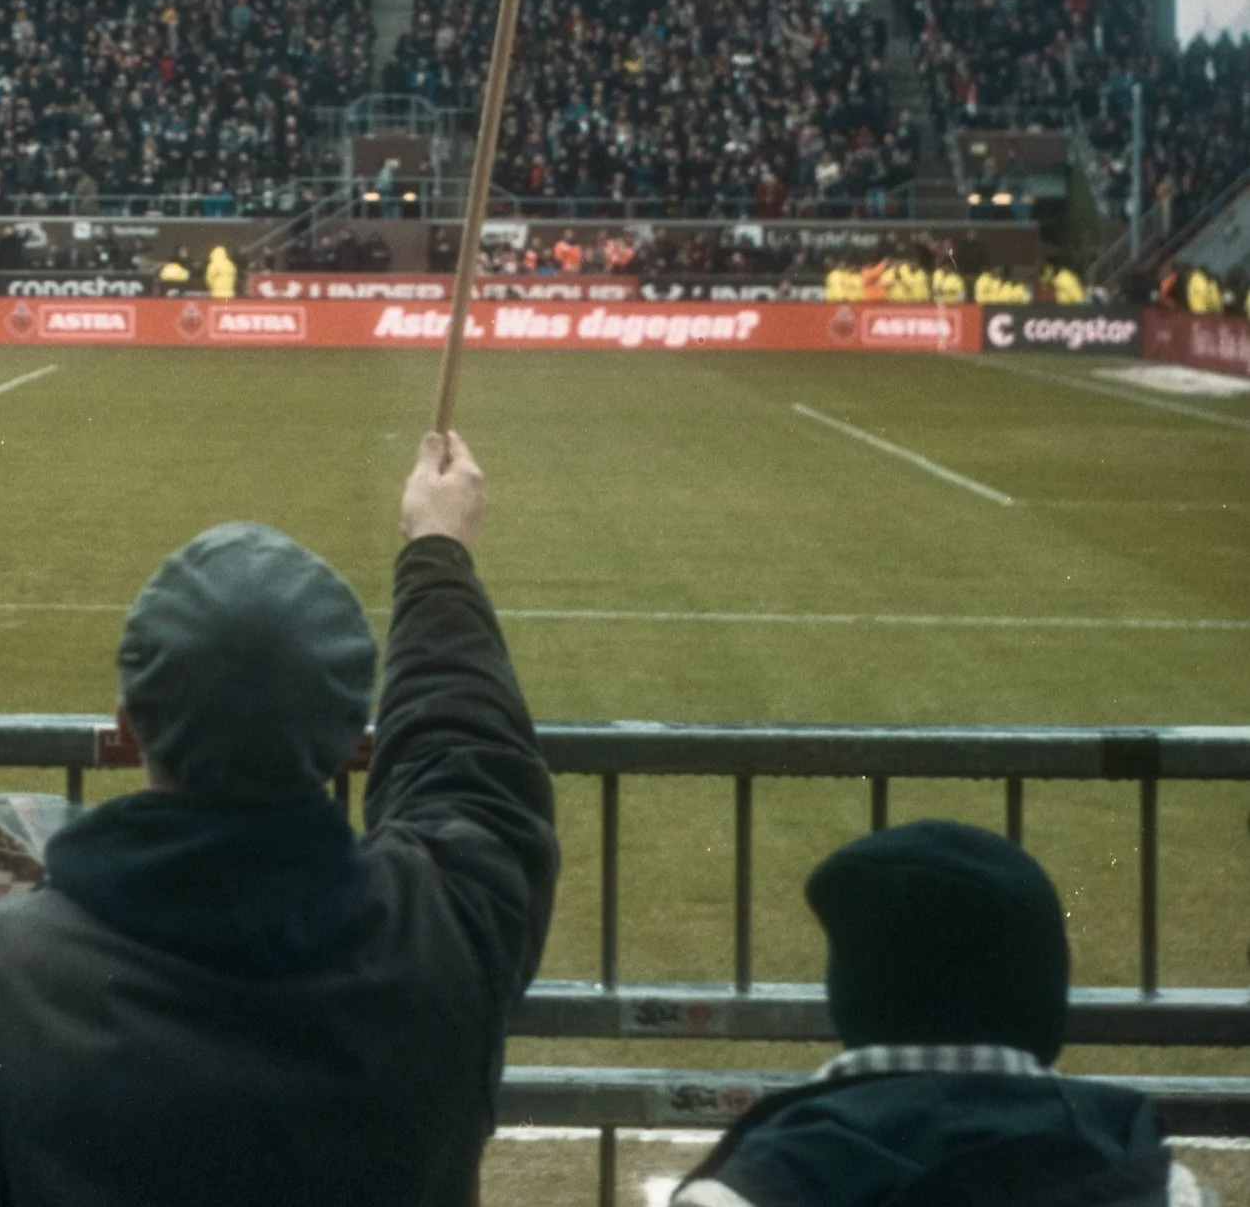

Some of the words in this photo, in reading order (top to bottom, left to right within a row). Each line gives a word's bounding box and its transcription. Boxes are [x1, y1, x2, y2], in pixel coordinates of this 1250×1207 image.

[47, 313, 125, 329] ASTRA
[218, 314, 296, 331] ASTRA
[493, 307, 569, 338] Was
[577, 307, 759, 347] dagegen?
[870, 318, 951, 337] ASTRA
[1023, 316, 1137, 347] congstar
